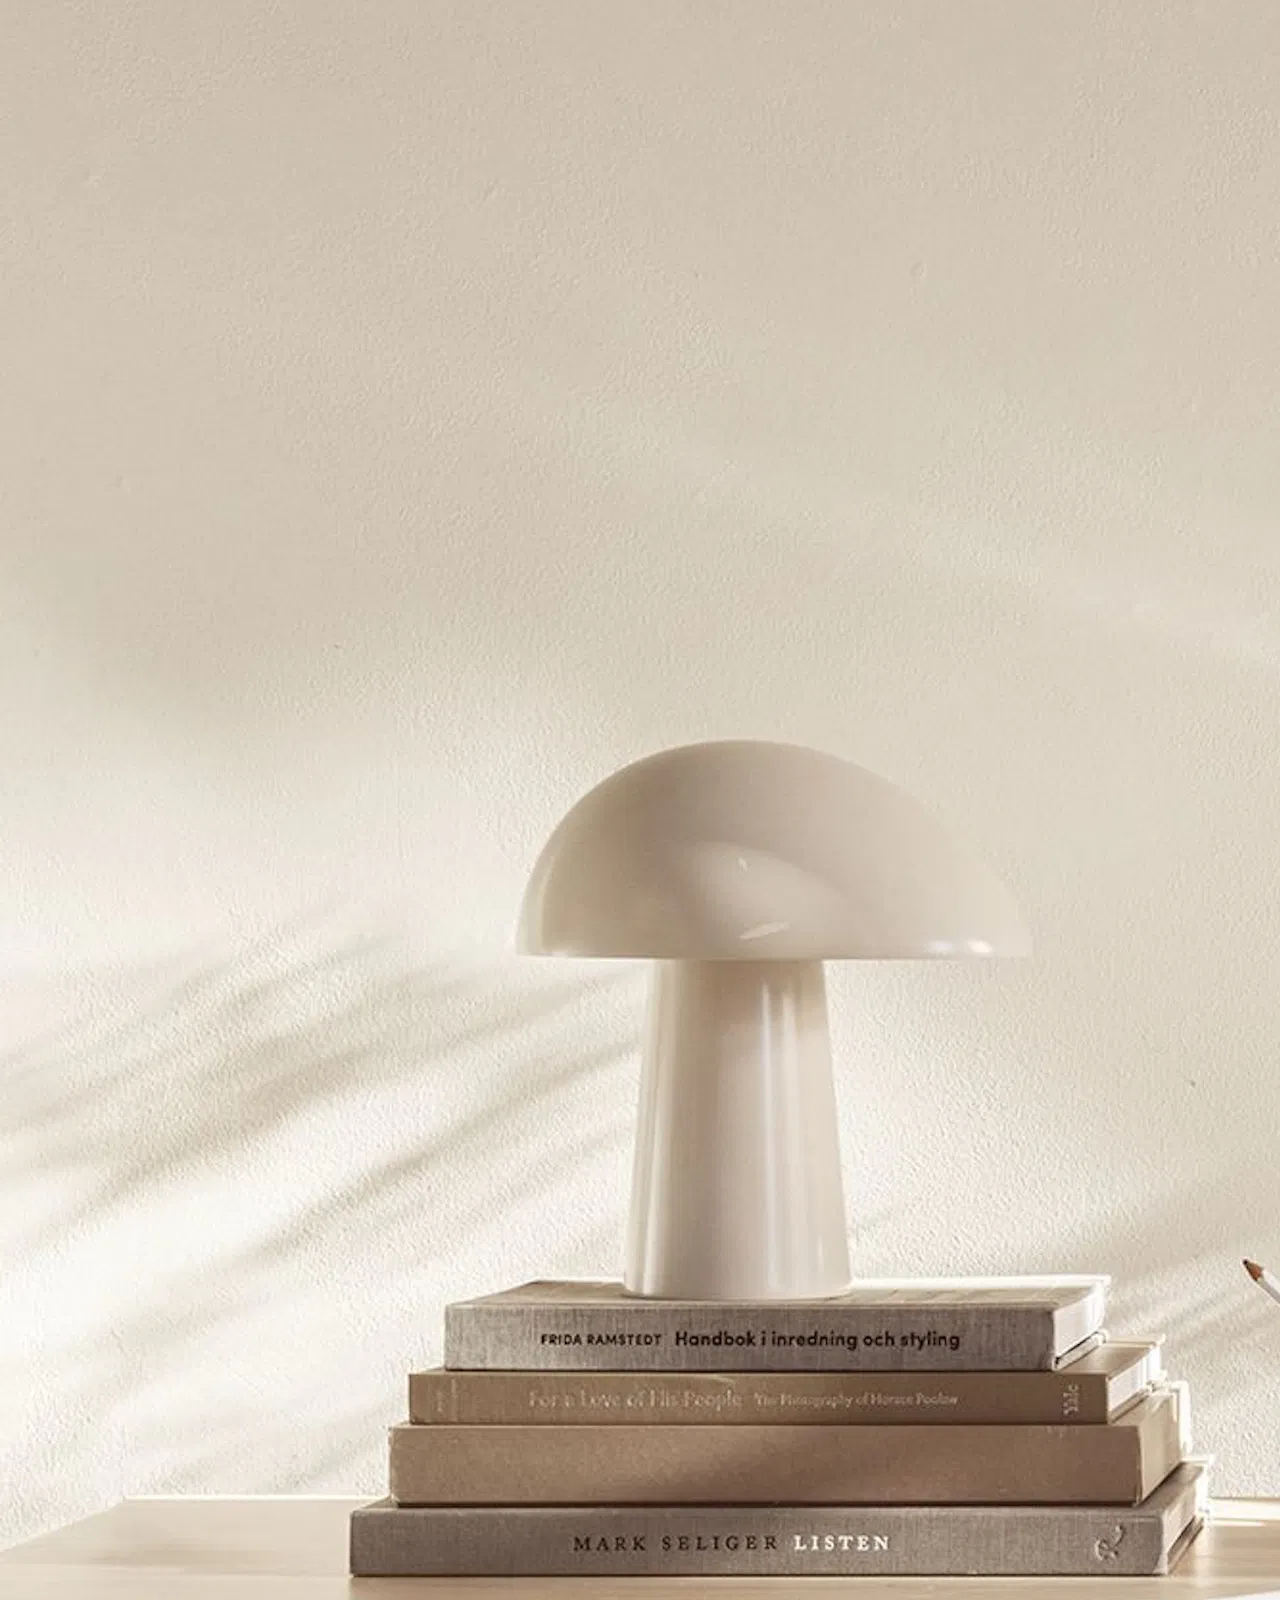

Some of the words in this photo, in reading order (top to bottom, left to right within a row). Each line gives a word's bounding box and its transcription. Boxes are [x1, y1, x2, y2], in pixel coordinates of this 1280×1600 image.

[540, 1333, 582, 1346] FRIDA
[587, 1333, 661, 1346] RAMSTEDT
[675, 1331, 756, 1347] Handbok
[761, 1330, 766, 1347] i
[771, 1330, 858, 1351] inredning
[863, 1330, 895, 1347] och
[900, 1330, 961, 1351] styling
[529, 1390, 558, 1408] For
[580, 1388, 622, 1408] Love
[626, 1389, 647, 1408] of
[684, 1389, 743, 1412] People
[573, 1536, 647, 1551] MARK
[661, 1536, 778, 1551] SELIGER
[793, 1534, 890, 1551] LISTEN
